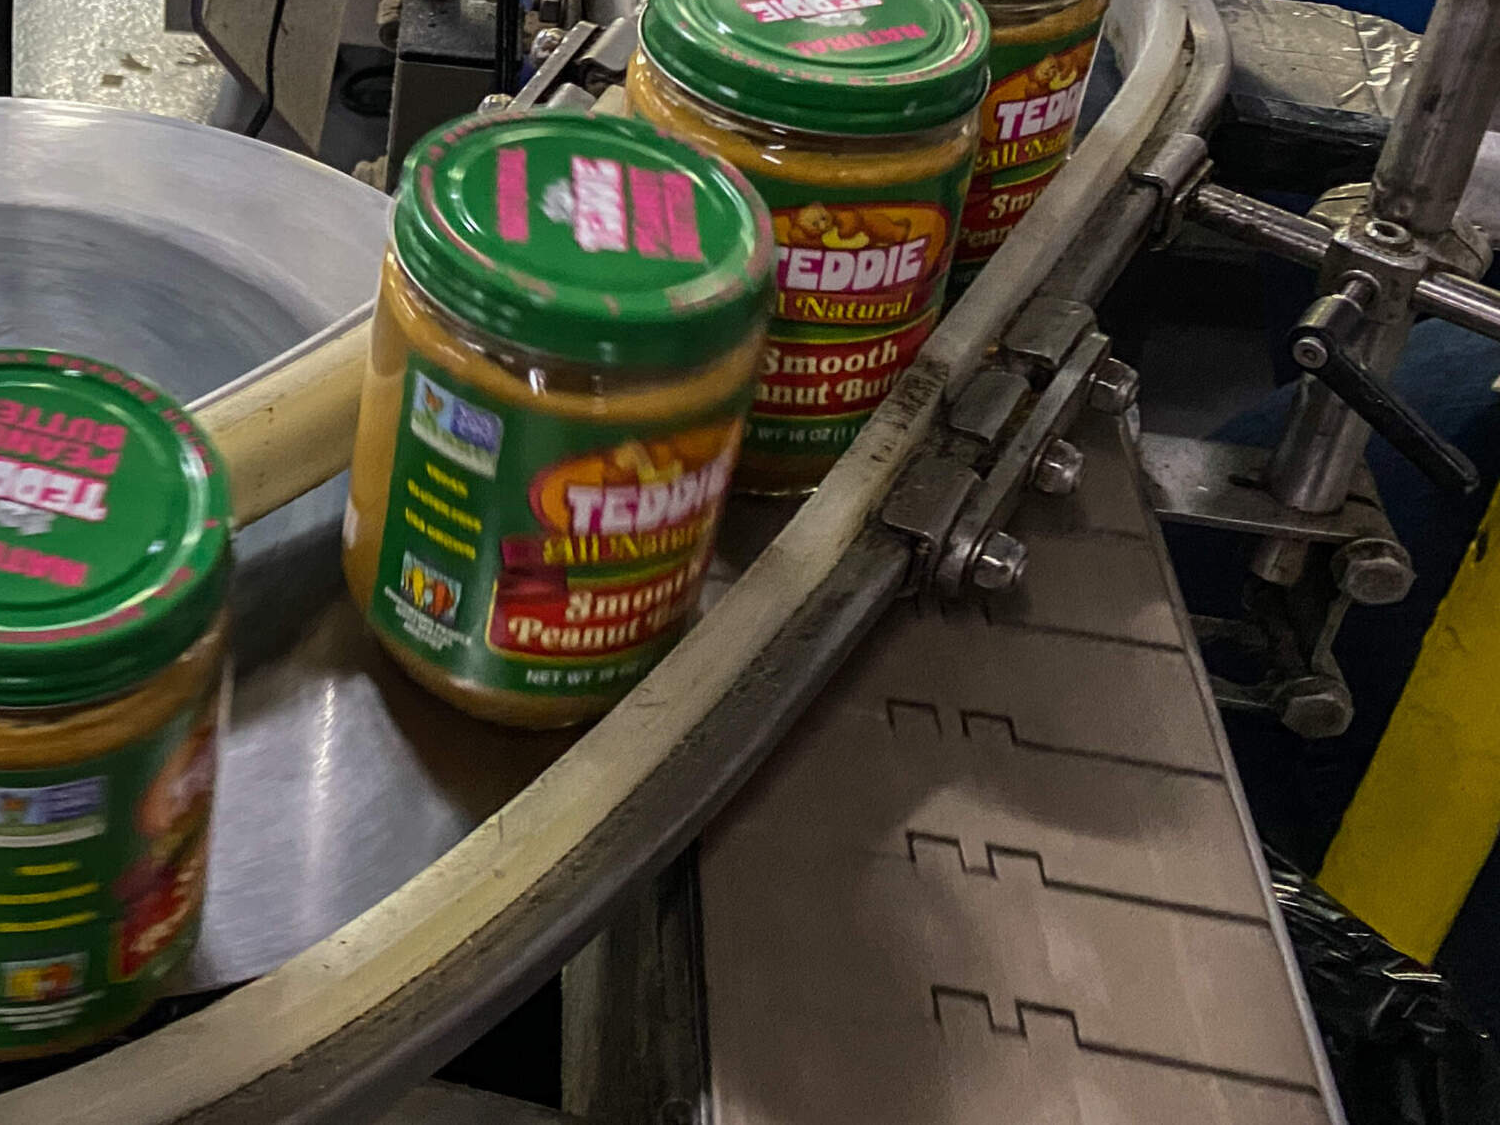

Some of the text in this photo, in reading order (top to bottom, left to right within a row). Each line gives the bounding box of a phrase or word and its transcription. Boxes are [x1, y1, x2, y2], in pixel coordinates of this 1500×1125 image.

[996, 80, 1085, 141] TEDD
[796, 291, 913, 319] Natural
[763, 339, 898, 375] Smooth
[567, 455, 736, 536] TEDDI
[507, 615, 641, 651] Peanut
